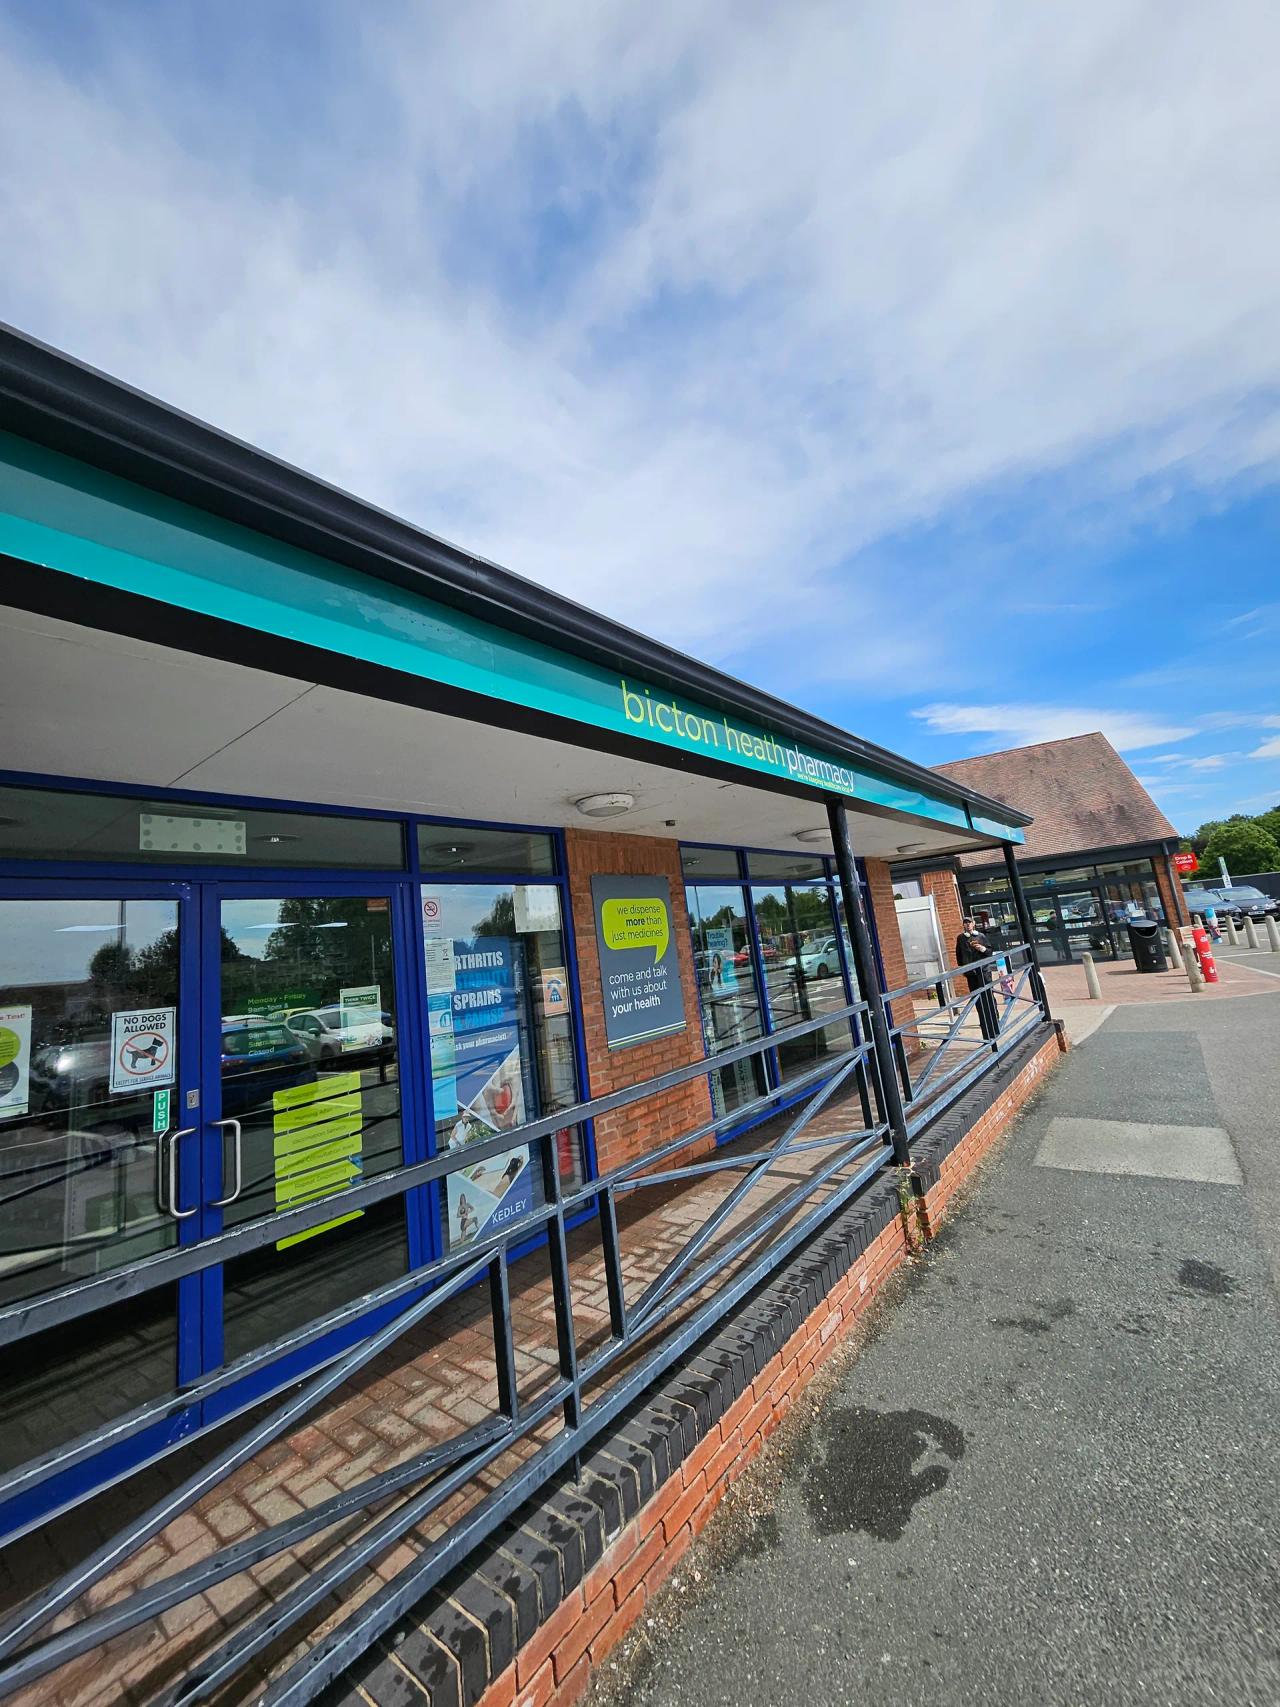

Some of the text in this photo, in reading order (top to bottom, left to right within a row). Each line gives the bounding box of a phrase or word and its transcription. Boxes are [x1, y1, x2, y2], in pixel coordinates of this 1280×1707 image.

[621, 680, 854, 792] bicton heath pharmacy
[617, 904, 660, 916] we dispense
[626, 916, 662, 927] more than
[612, 929, 663, 942] just medicines
[455, 951, 504, 970] RTHRITIS
[609, 965, 667, 985] come and talk
[453, 989, 502, 1010] SPRAINS
[611, 980, 667, 1000] with us about
[612, 995, 660, 1017] your health
[124, 1013, 167, 1025] NO DOGS
[124, 1022, 166, 1034] ALLOWED
[157, 1093, 166, 1128] PUSH
[492, 1198, 527, 1224] KEDLEY
